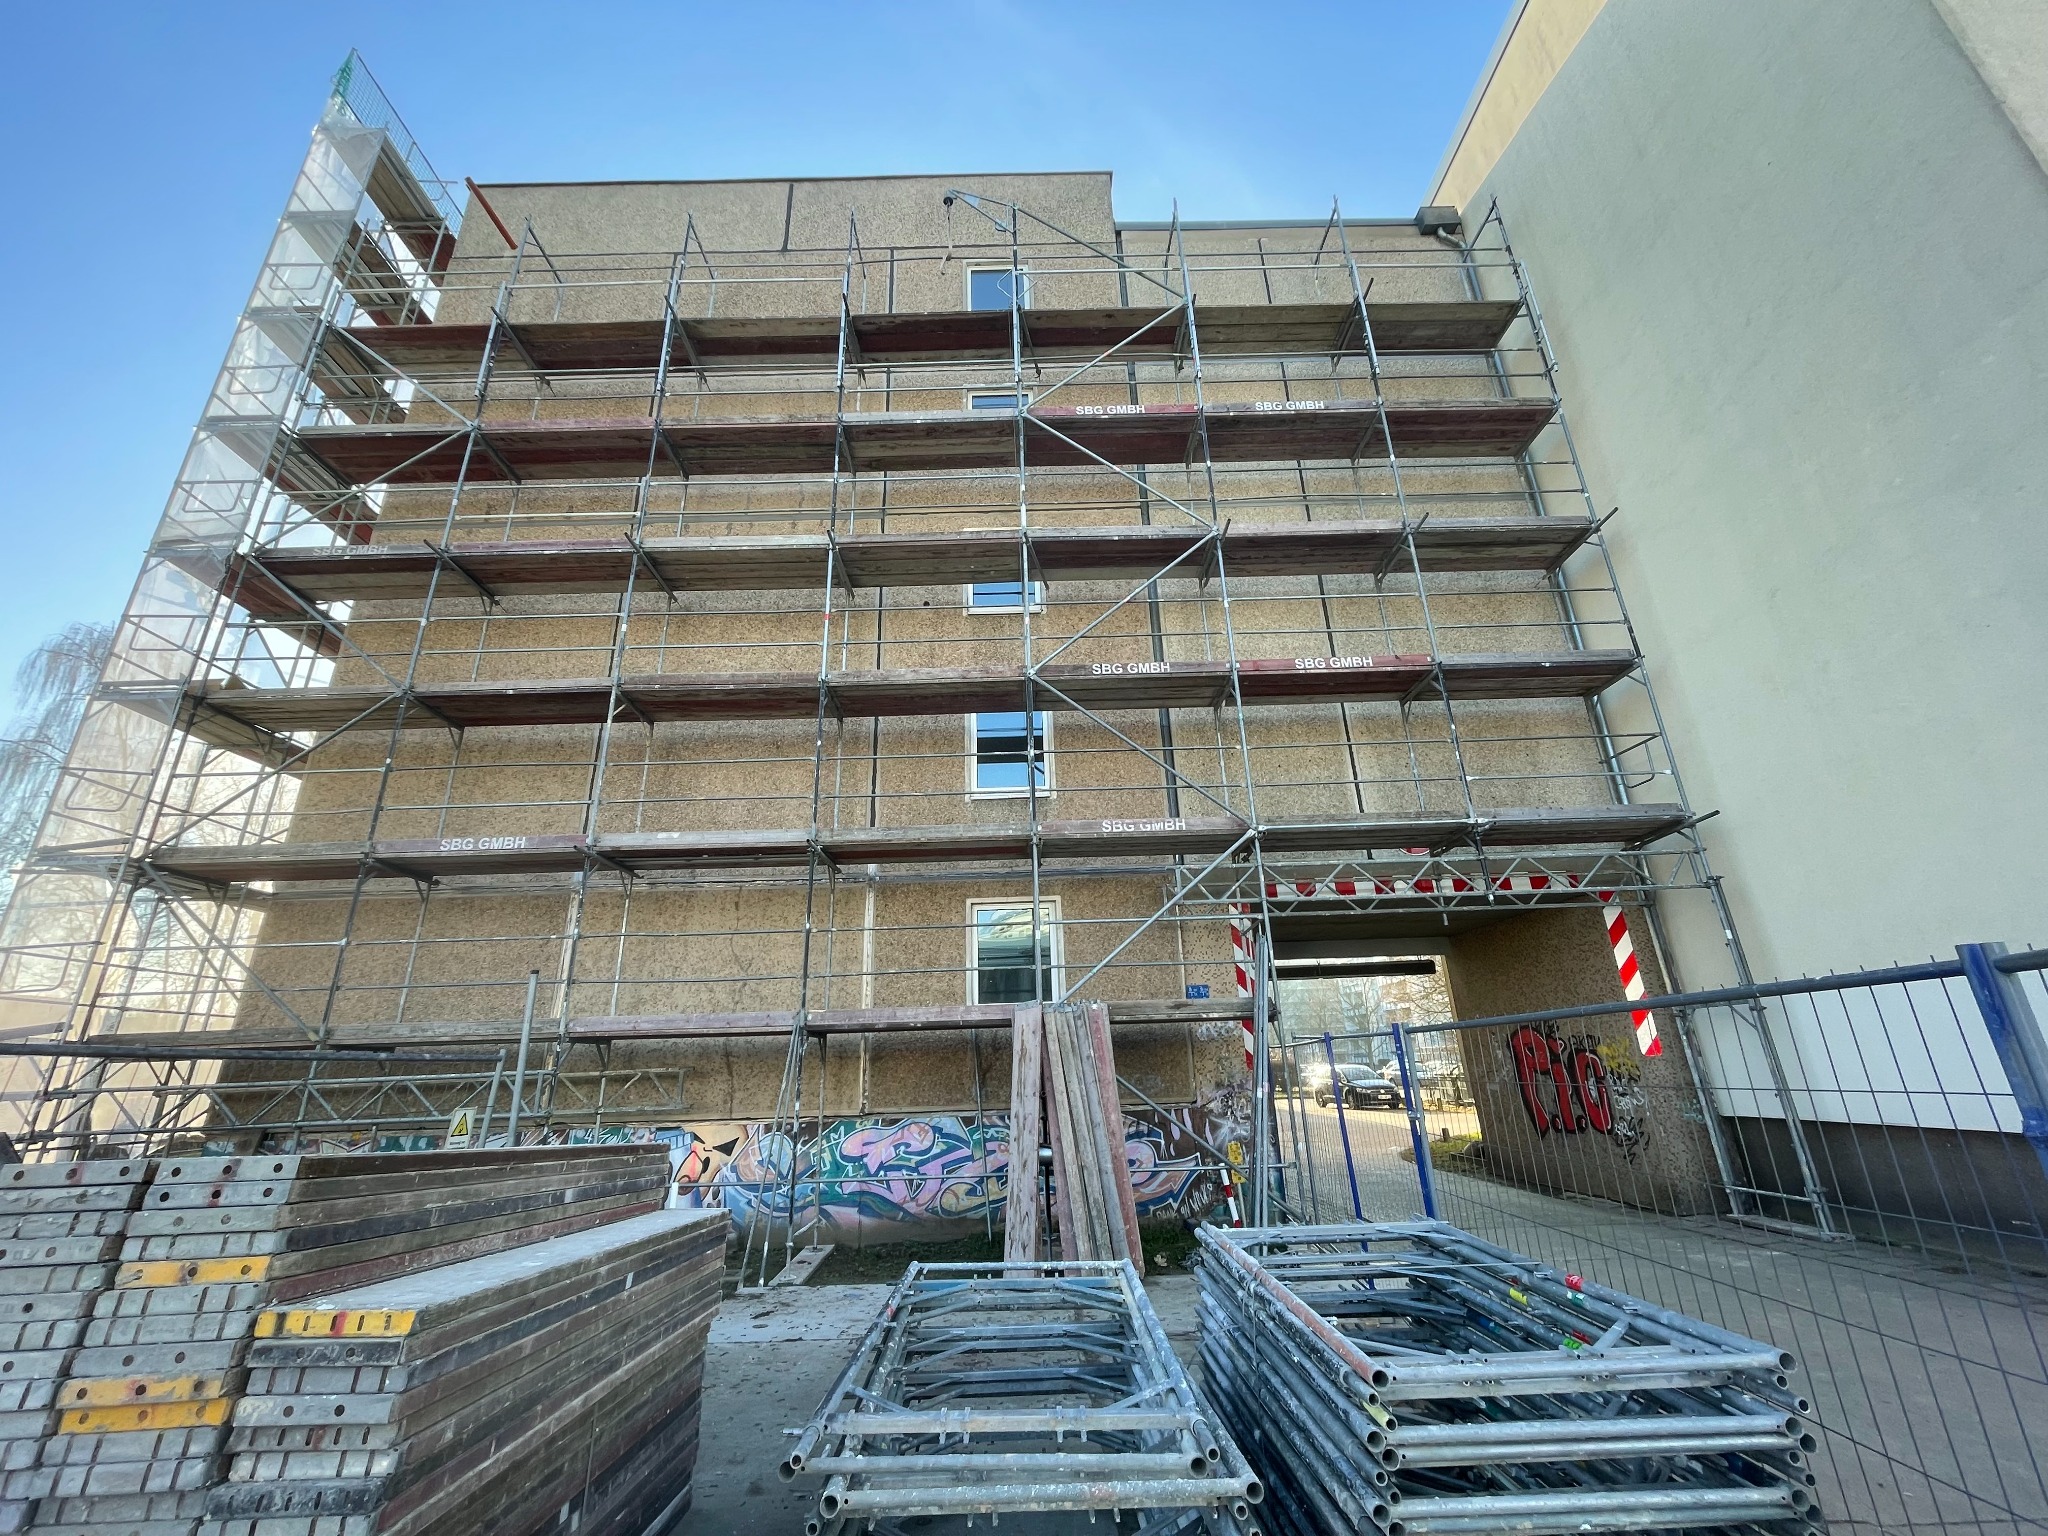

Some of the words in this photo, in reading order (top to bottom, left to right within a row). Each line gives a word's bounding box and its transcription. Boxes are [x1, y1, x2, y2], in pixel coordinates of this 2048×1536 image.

[1075, 405, 1104, 415] SBG
[1106, 404, 1146, 414] GMBH
[1255, 401, 1283, 411] SBG
[1285, 400, 1325, 410] GMBH
[312, 546, 343, 556] SBG
[346, 544, 389, 555] GMBH
[1091, 663, 1123, 674] SBG
[1127, 662, 1170, 674] GMBH
[1294, 657, 1326, 669] SBG
[1329, 656, 1374, 668] GMBH
[1101, 819, 1135, 832] SBG
[1139, 818, 1186, 832] GMBH
[439, 837, 474, 851] SBG
[478, 836, 526, 850] GMBH
